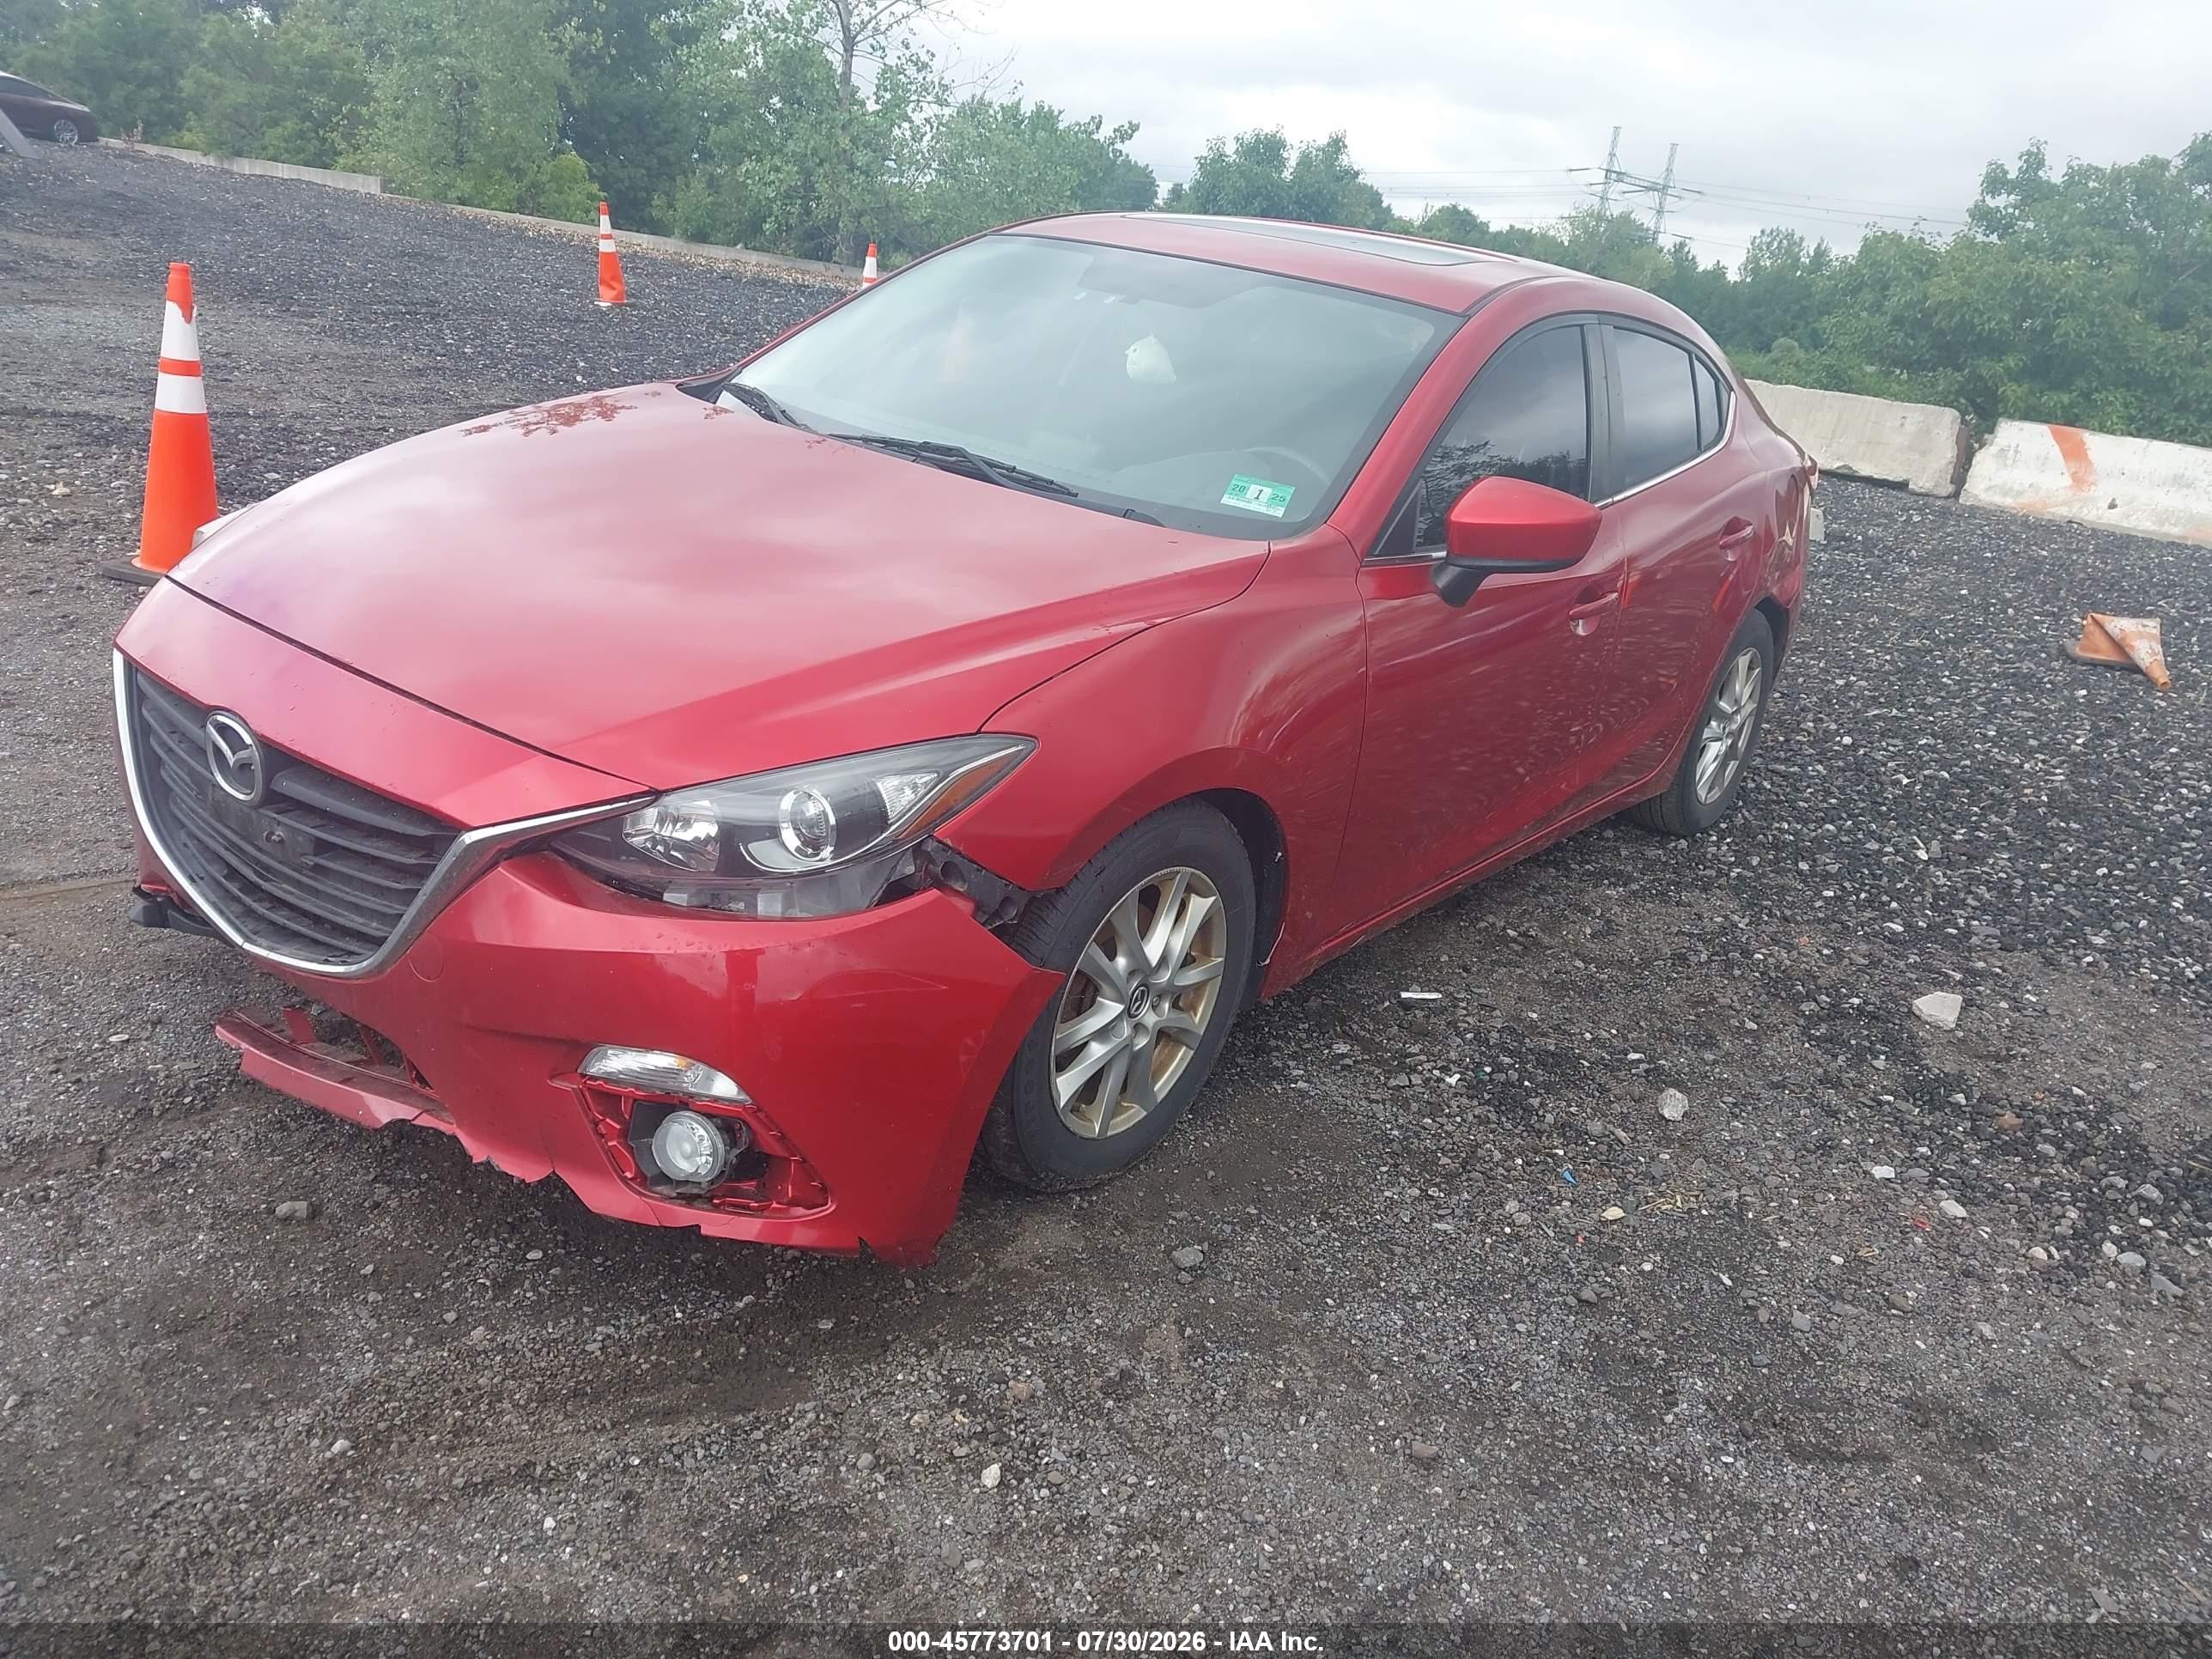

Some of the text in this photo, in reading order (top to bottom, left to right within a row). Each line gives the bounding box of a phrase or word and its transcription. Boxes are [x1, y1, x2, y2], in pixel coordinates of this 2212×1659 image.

[1231, 483, 1246, 493] 20
[1254, 489, 1263, 500] 1
[1271, 493, 1287, 502] 25
